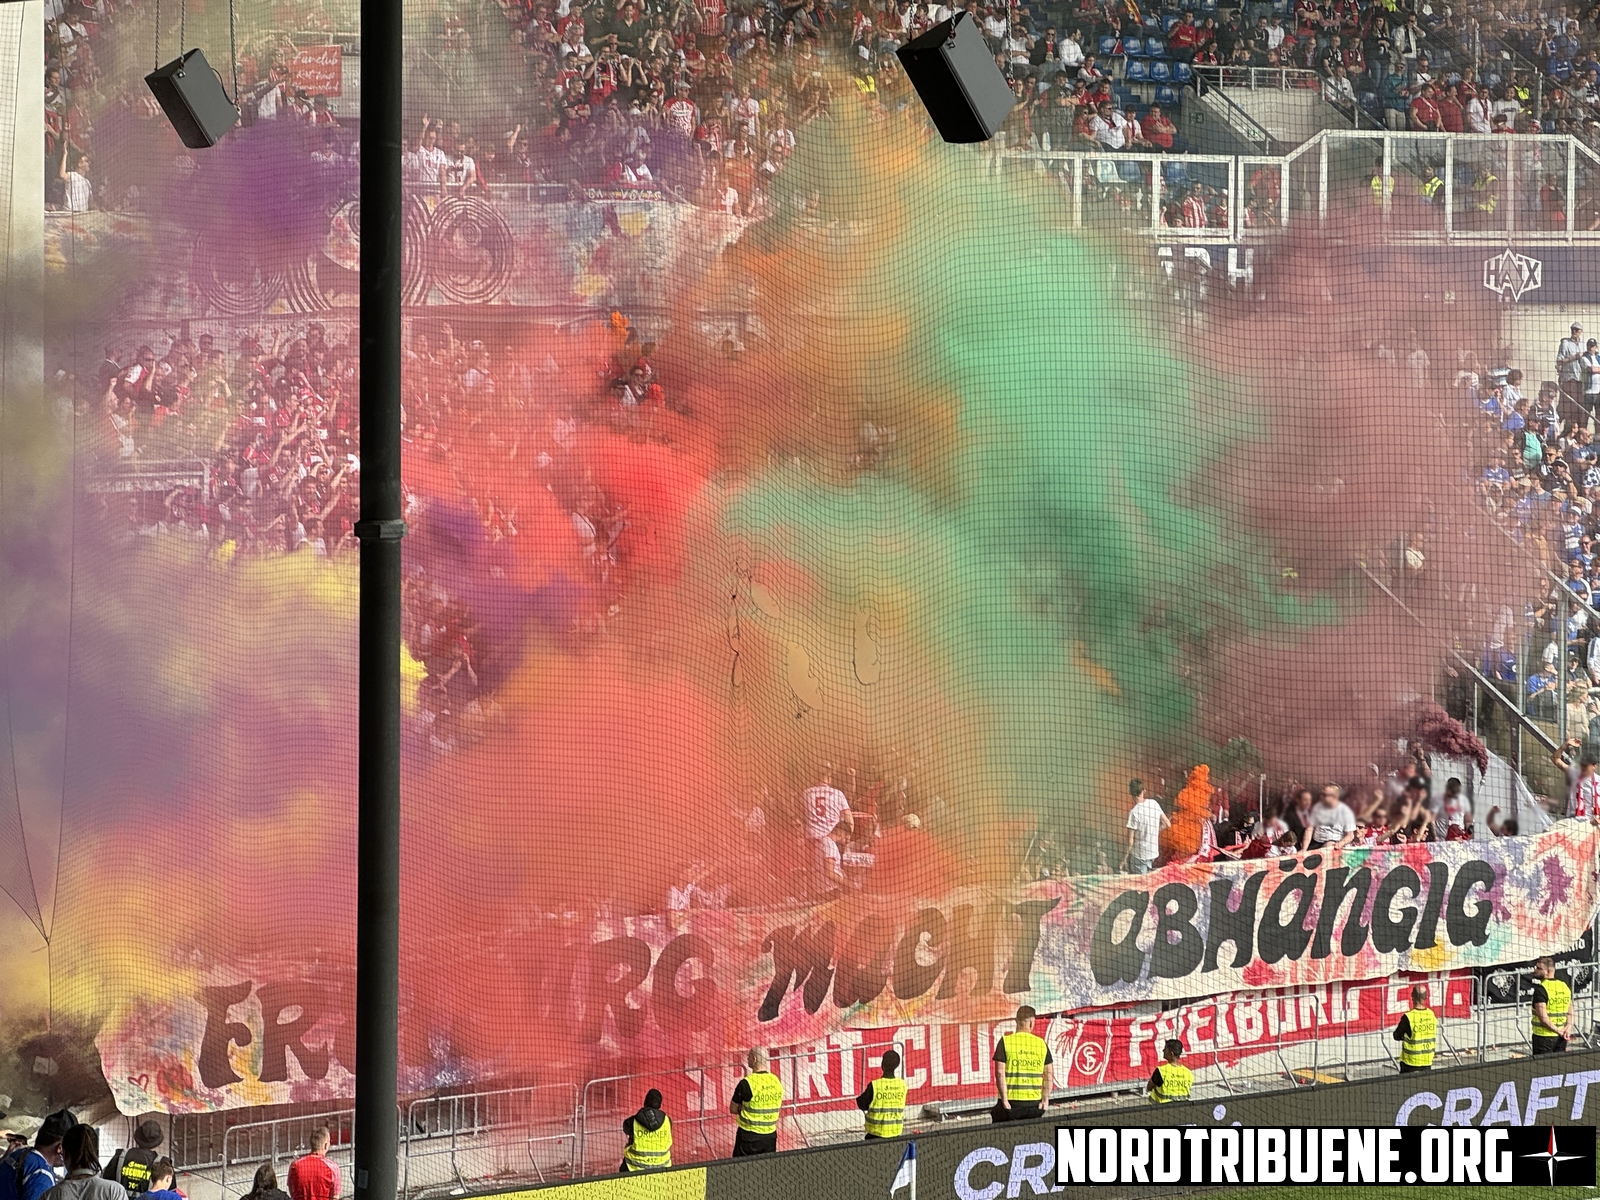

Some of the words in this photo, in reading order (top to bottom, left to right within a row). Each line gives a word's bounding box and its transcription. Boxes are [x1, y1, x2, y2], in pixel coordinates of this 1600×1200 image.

[815, 796, 827, 817] 5
[1011, 1059, 1042, 1068] ORDNER
[1163, 1079, 1191, 1089] ORDNER
[754, 1092, 782, 1103] ORDNER
[876, 1092, 905, 1100] ORDNER
[1396, 1069, 1600, 1127] CRAFT
[637, 1129, 667, 1139] ORDNER
